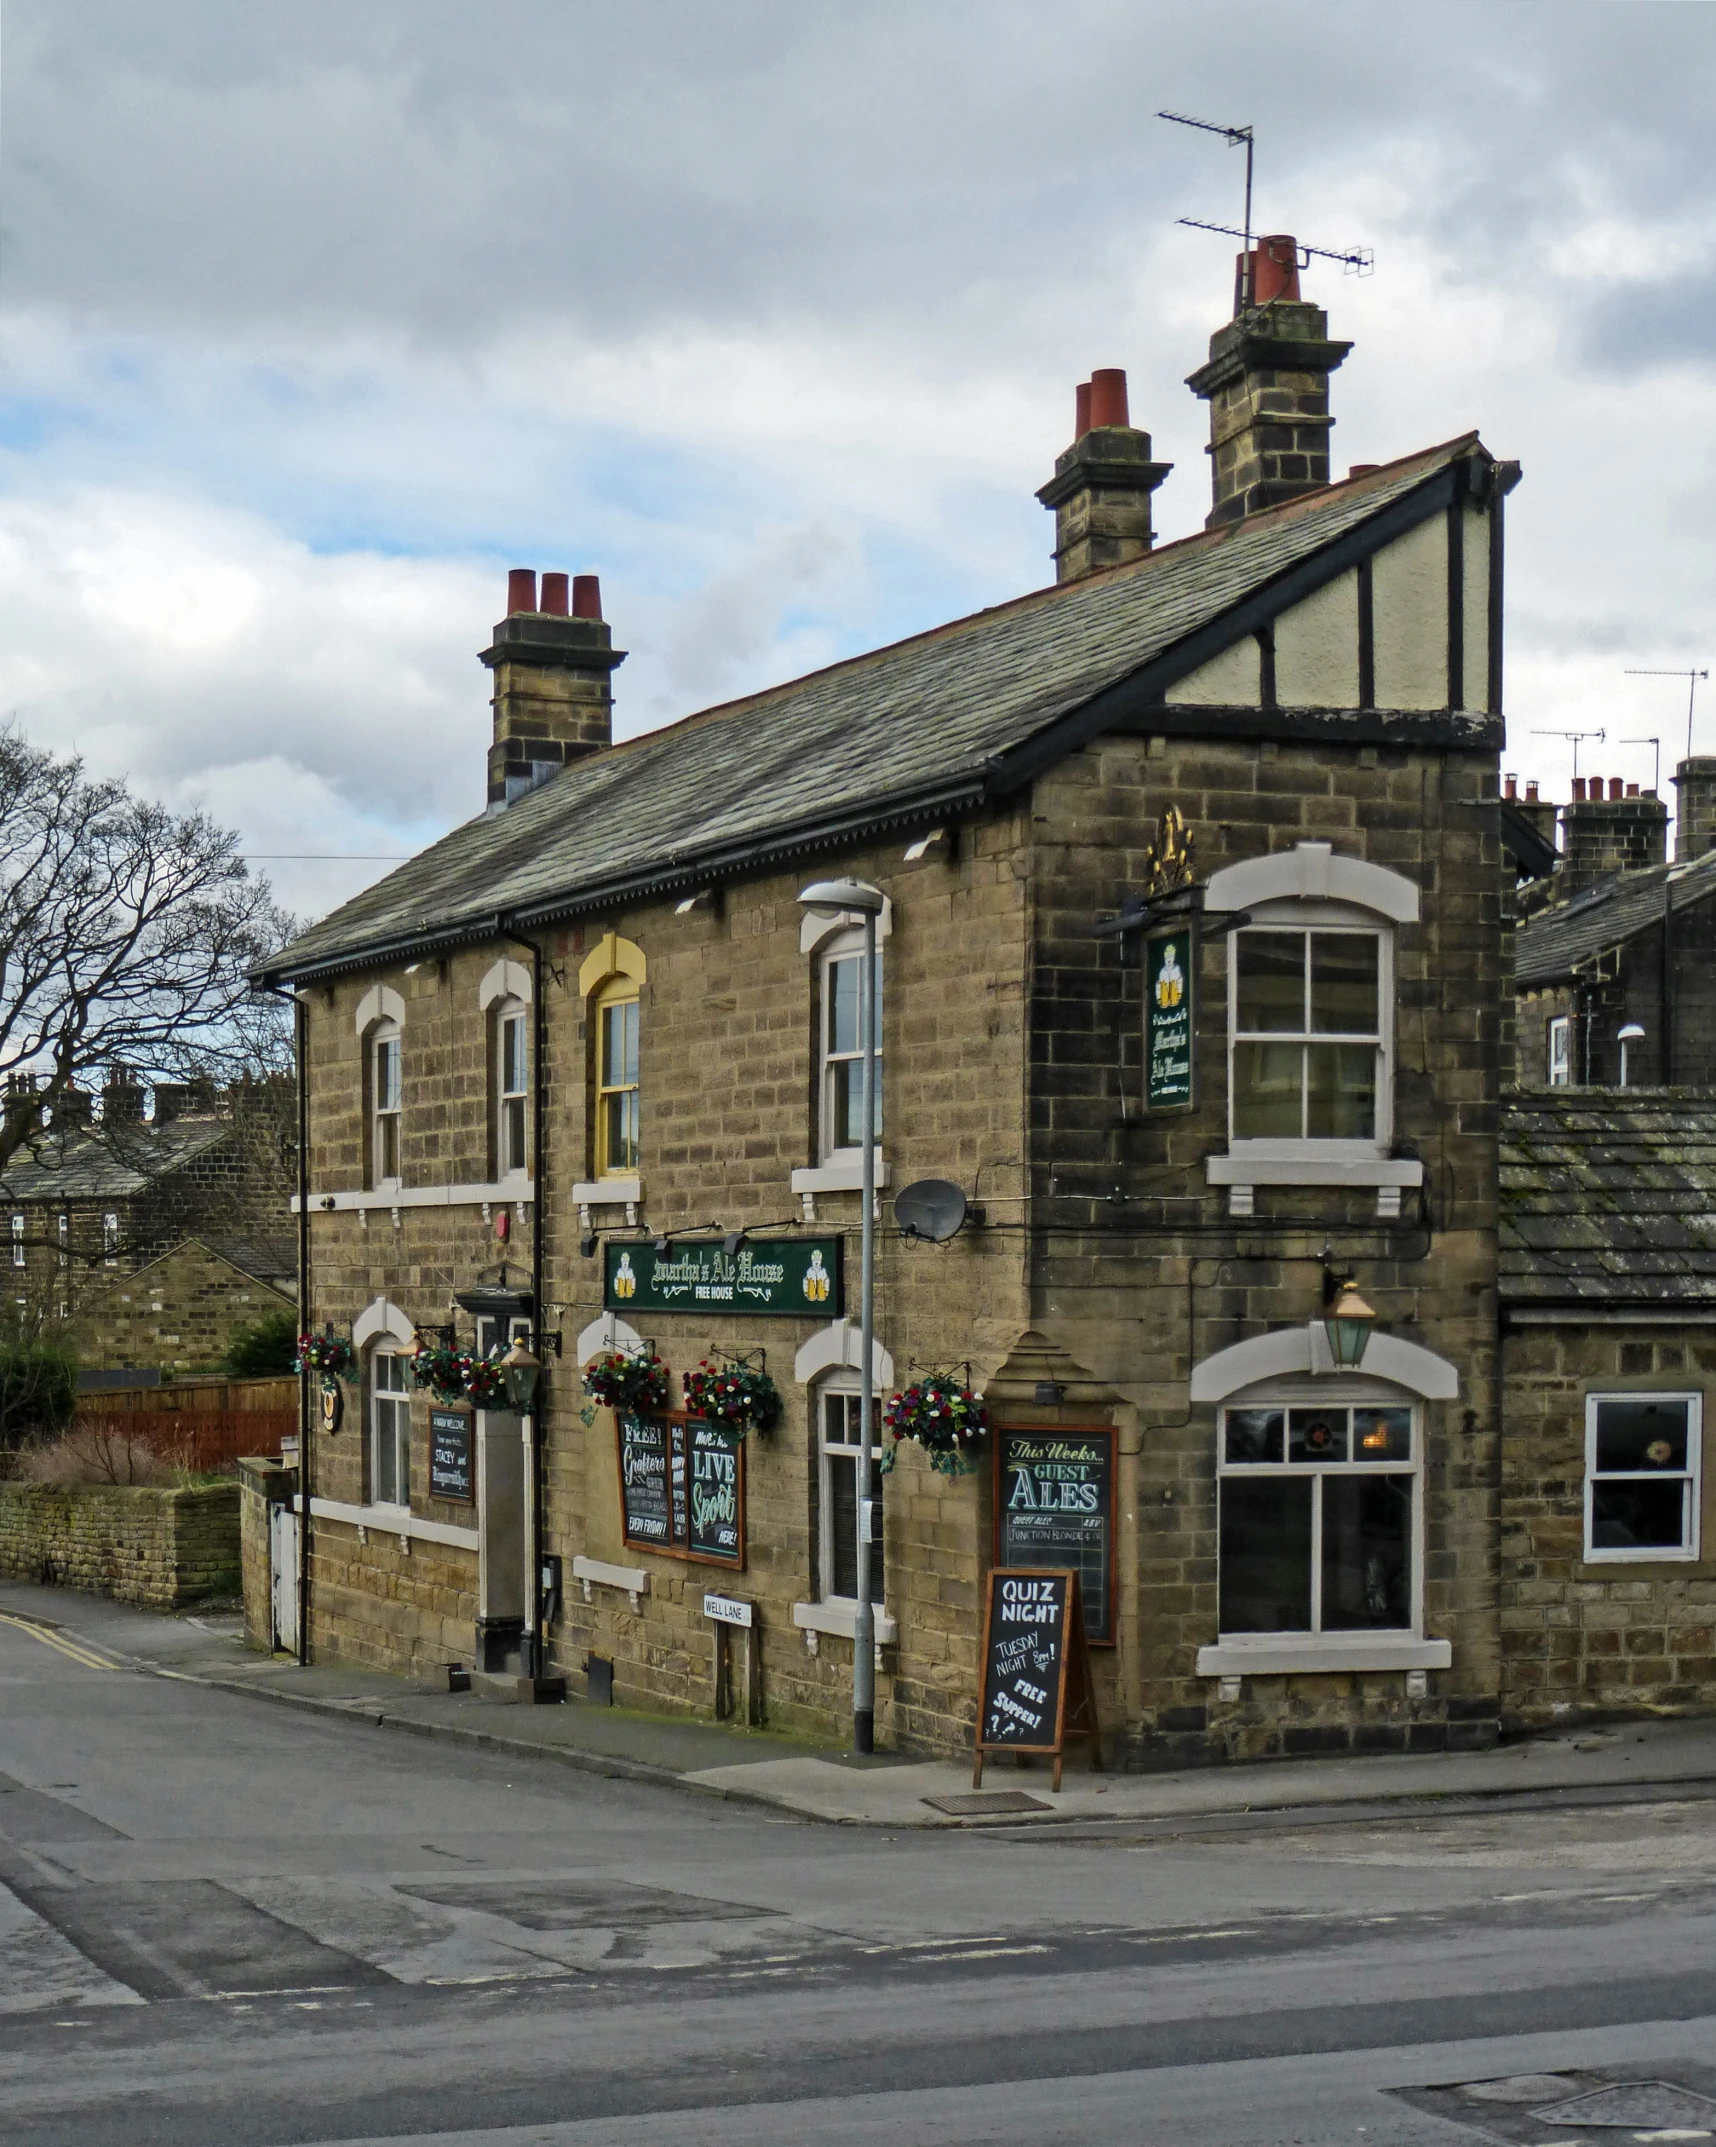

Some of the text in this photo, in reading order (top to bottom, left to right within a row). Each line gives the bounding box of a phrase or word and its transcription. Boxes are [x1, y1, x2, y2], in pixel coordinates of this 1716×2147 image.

[710, 1251, 736, 1284] Ale
[737, 1251, 784, 1292] House
[695, 1286, 734, 1300] FREE HOUSE
[624, 1424, 662, 1446] FREE!
[435, 1449, 455, 1464] STACEY
[1010, 1440, 1043, 1458] This
[624, 1445, 666, 1485] Grafters
[692, 1450, 735, 1484] LIVE
[1034, 1464, 1090, 1480] GUEST
[1008, 1468, 1099, 1513] ALES
[692, 1482, 736, 1538] Sport
[629, 1516, 644, 1532] EVERY
[643, 1518, 667, 1537] FRIDAY!
[1084, 1519, 1101, 1527] ABV
[1009, 1528, 1051, 1541] JUNCTION
[1052, 1529, 1084, 1541] BLONDE
[1002, 1581, 1055, 1602] QUIZ
[706, 1600, 723, 1615] WELL
[724, 1604, 742, 1620] LANE
[1002, 1604, 1059, 1623] NIGHT
[996, 1631, 1039, 1658] TUESDAY
[996, 1654, 1027, 1677] NIGHT
[1014, 1679, 1047, 1704] FREE
[992, 1691, 1042, 1729] SUPPER!
